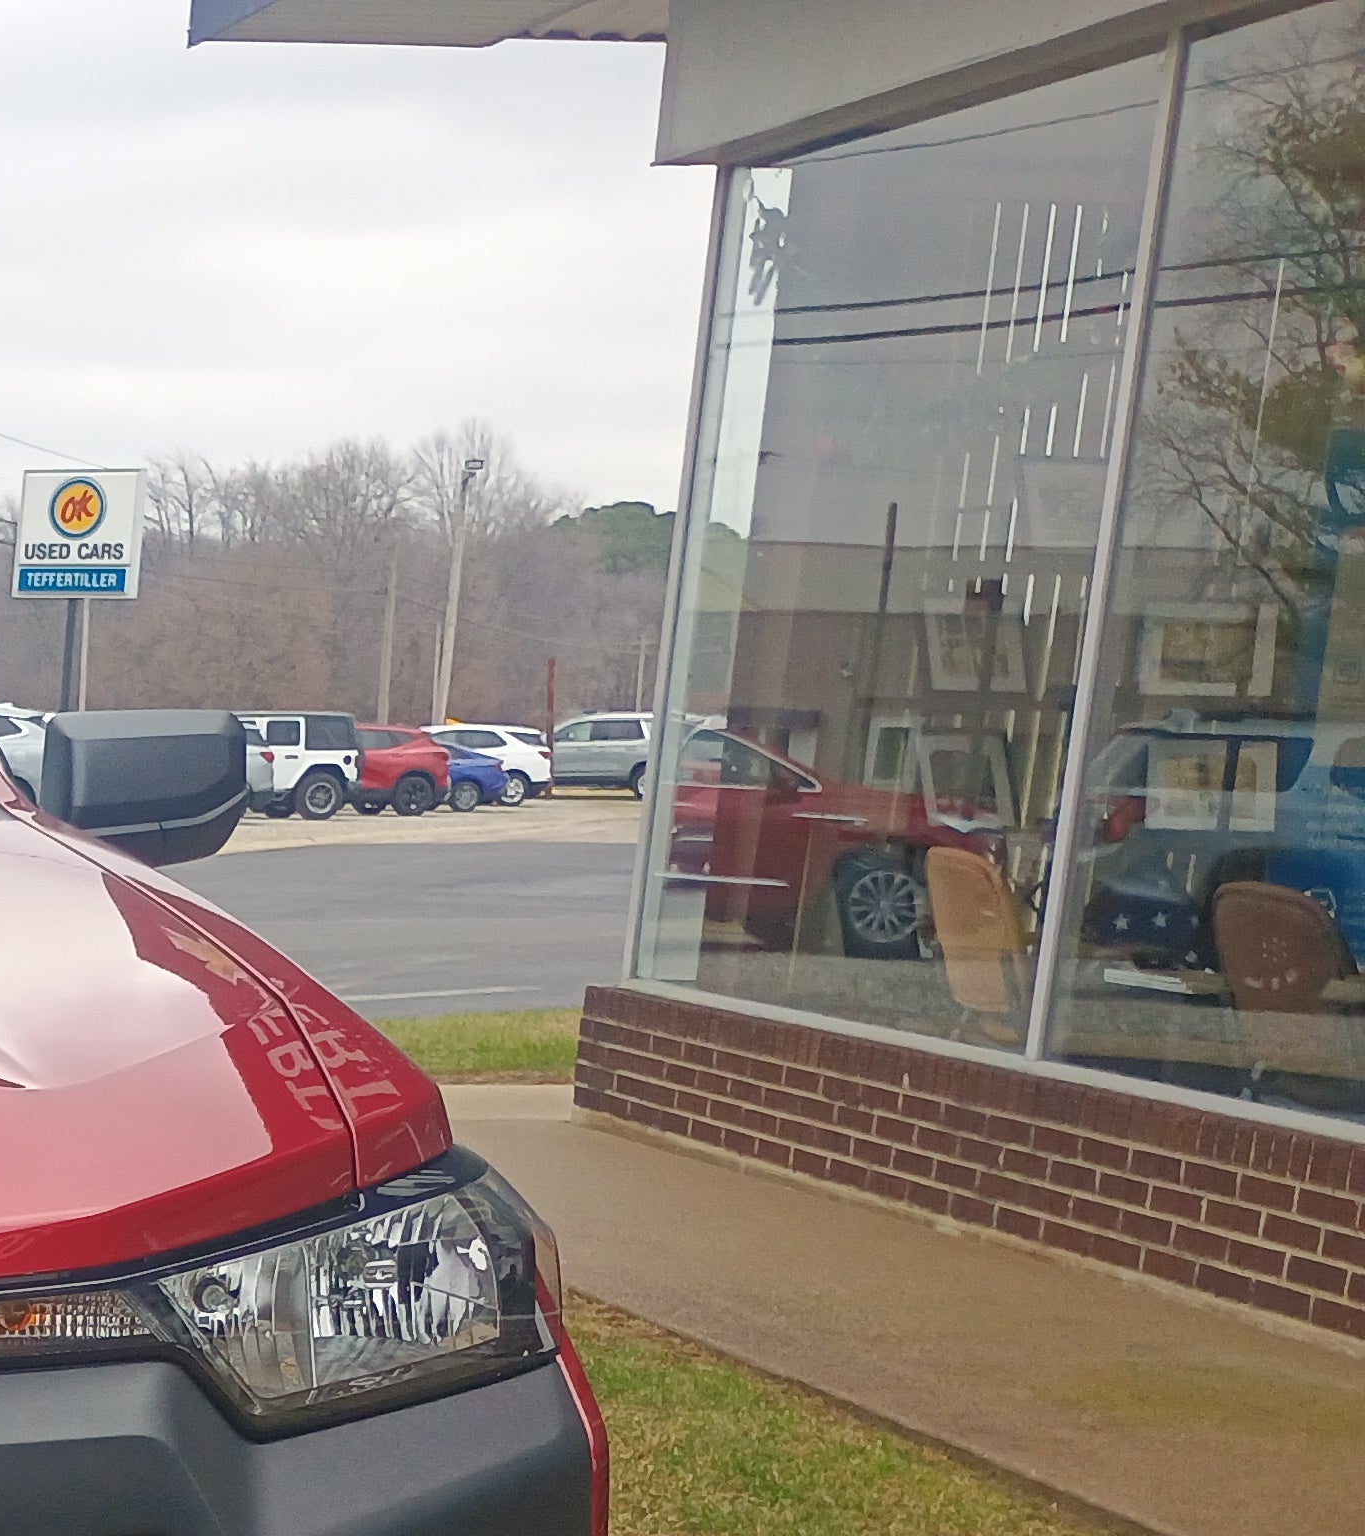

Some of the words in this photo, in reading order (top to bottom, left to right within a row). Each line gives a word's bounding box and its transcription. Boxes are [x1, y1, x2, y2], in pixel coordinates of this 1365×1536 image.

[60, 489, 94, 524] OK
[24, 543, 70, 560] USED
[77, 543, 124, 560] CARS
[27, 572, 117, 587] TEFFERTILLER
